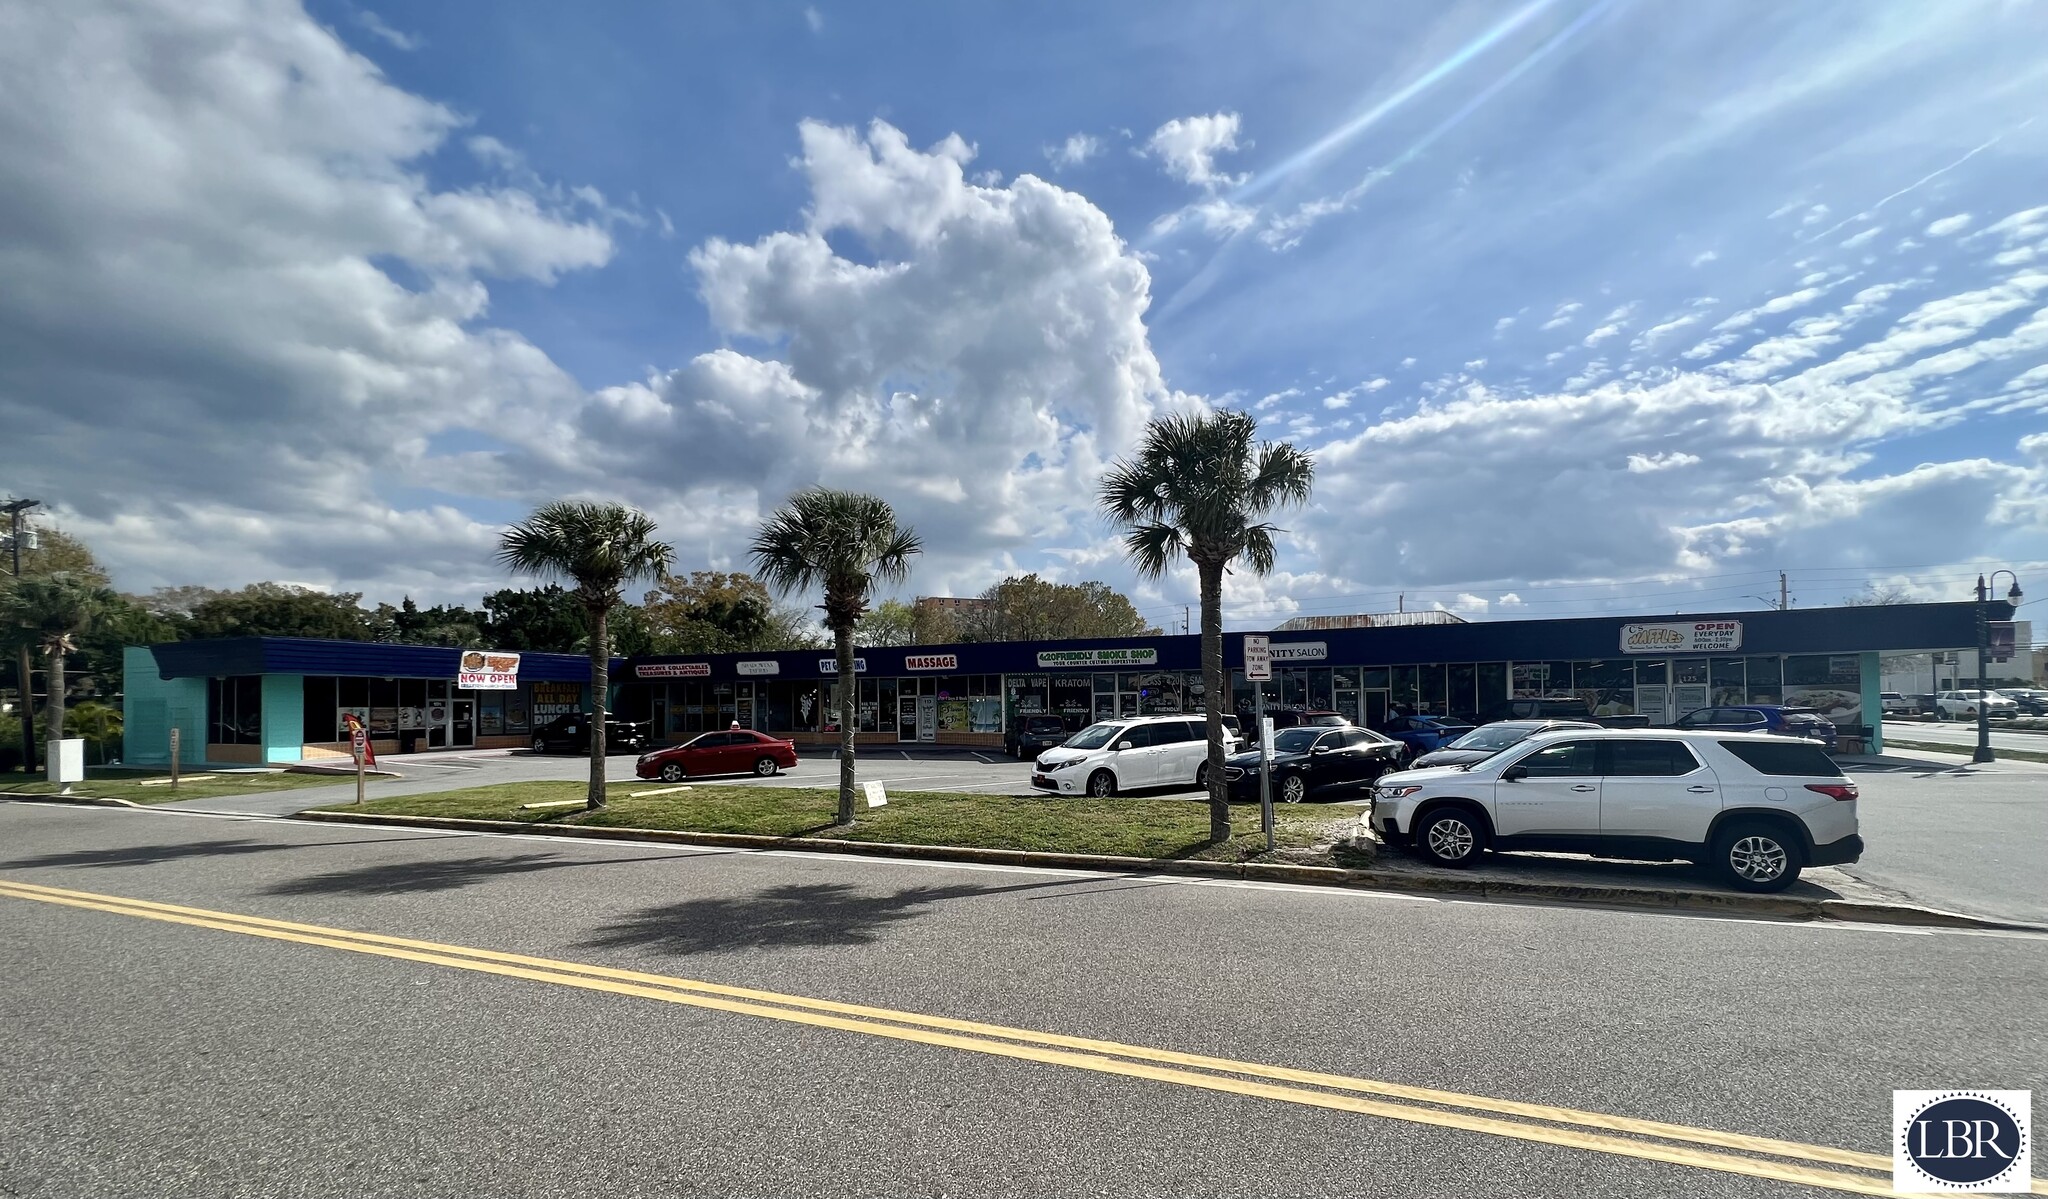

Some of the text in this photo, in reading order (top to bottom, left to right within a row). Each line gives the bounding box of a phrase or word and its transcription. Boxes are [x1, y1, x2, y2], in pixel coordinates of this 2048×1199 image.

[1097, 650, 1127, 659] SMOKE
[1131, 650, 1154, 658] SHOP
[1297, 648, 1325, 656] SALON
[821, 662, 831, 671] PET
[908, 657, 955, 668] MASSAGE
[461, 674, 514, 683] NOW OPEN
[1008, 678, 1047, 688] DELTA VAPE
[1055, 679, 1090, 687] KRATOM
[534, 683, 580, 693] BREAKFAST
[536, 694, 578, 703] ALL DAY
[534, 704, 580, 714] LUNCH &
